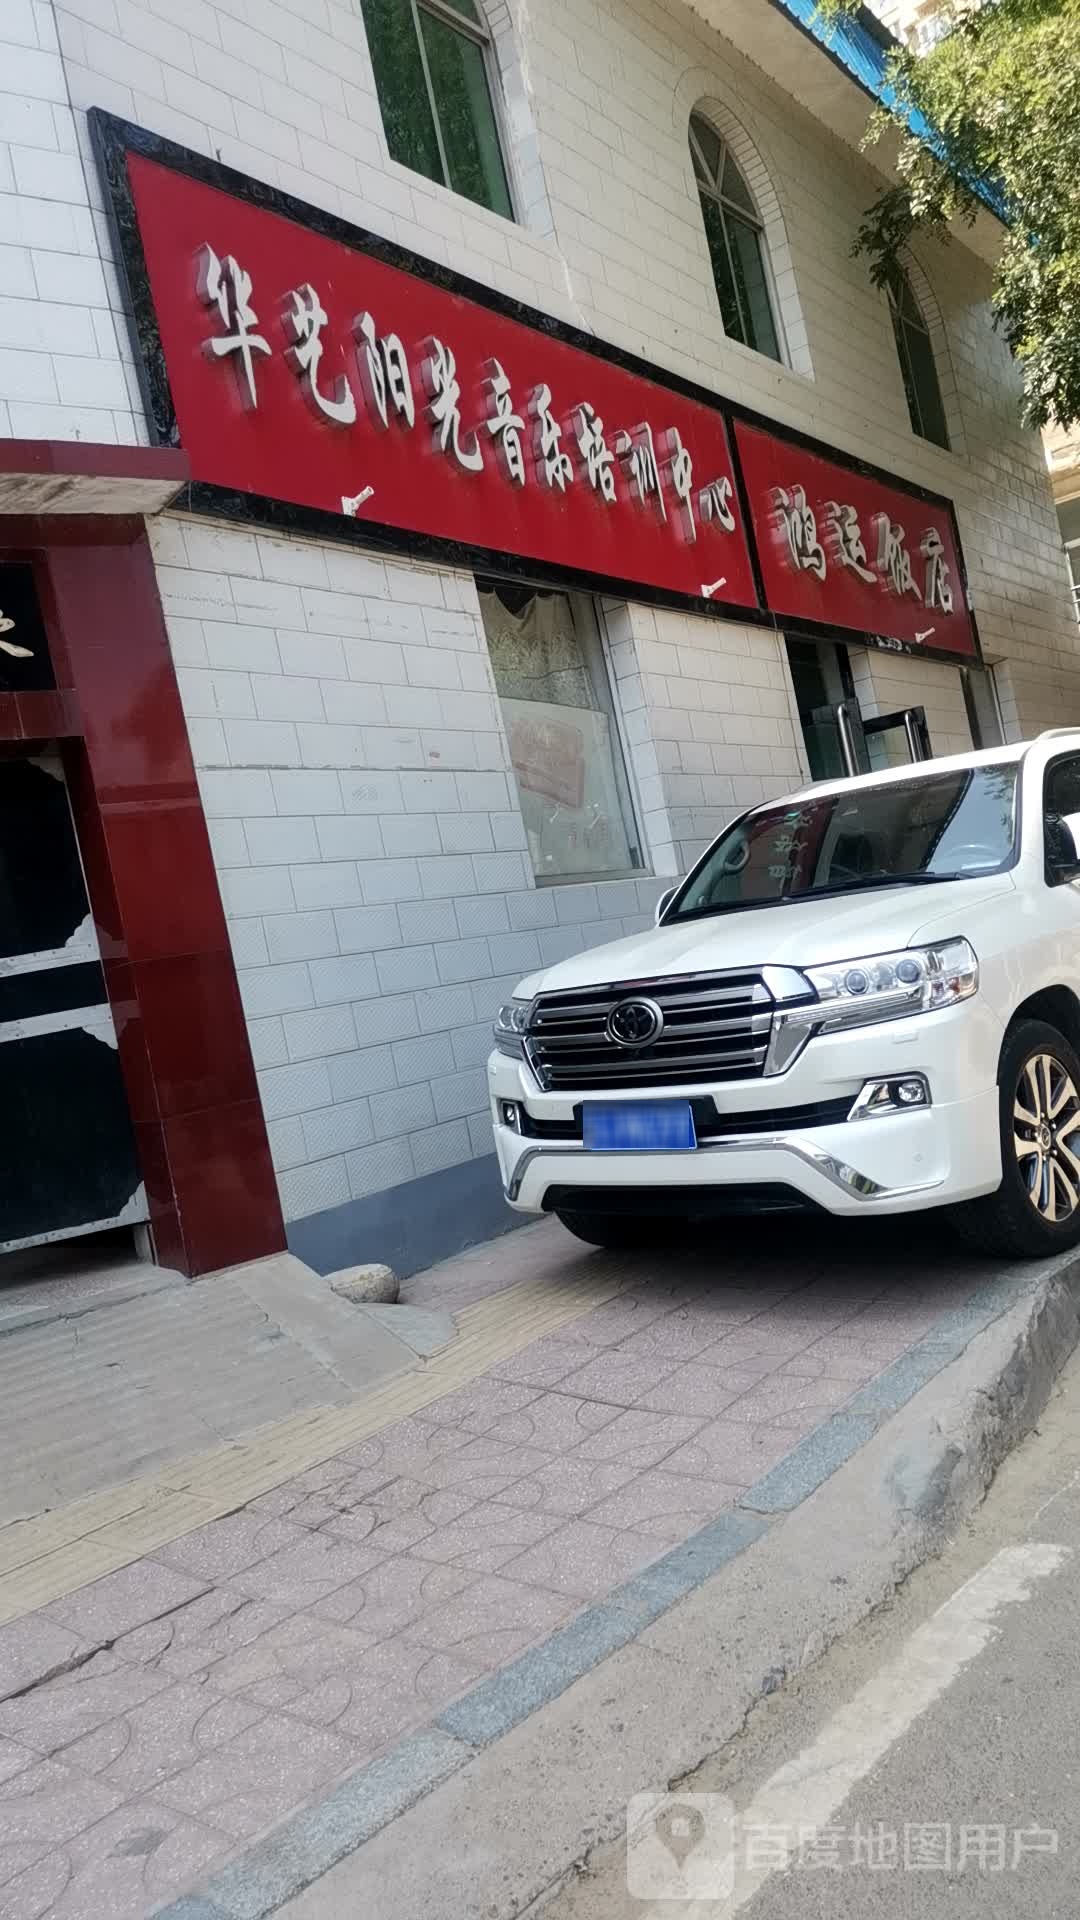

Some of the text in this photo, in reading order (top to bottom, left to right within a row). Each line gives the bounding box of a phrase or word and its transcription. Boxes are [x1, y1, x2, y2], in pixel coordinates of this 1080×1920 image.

[194, 241, 736, 544] 华艺阳光音乐培训中心
[769, 484, 954, 614] 鸿运饭店
